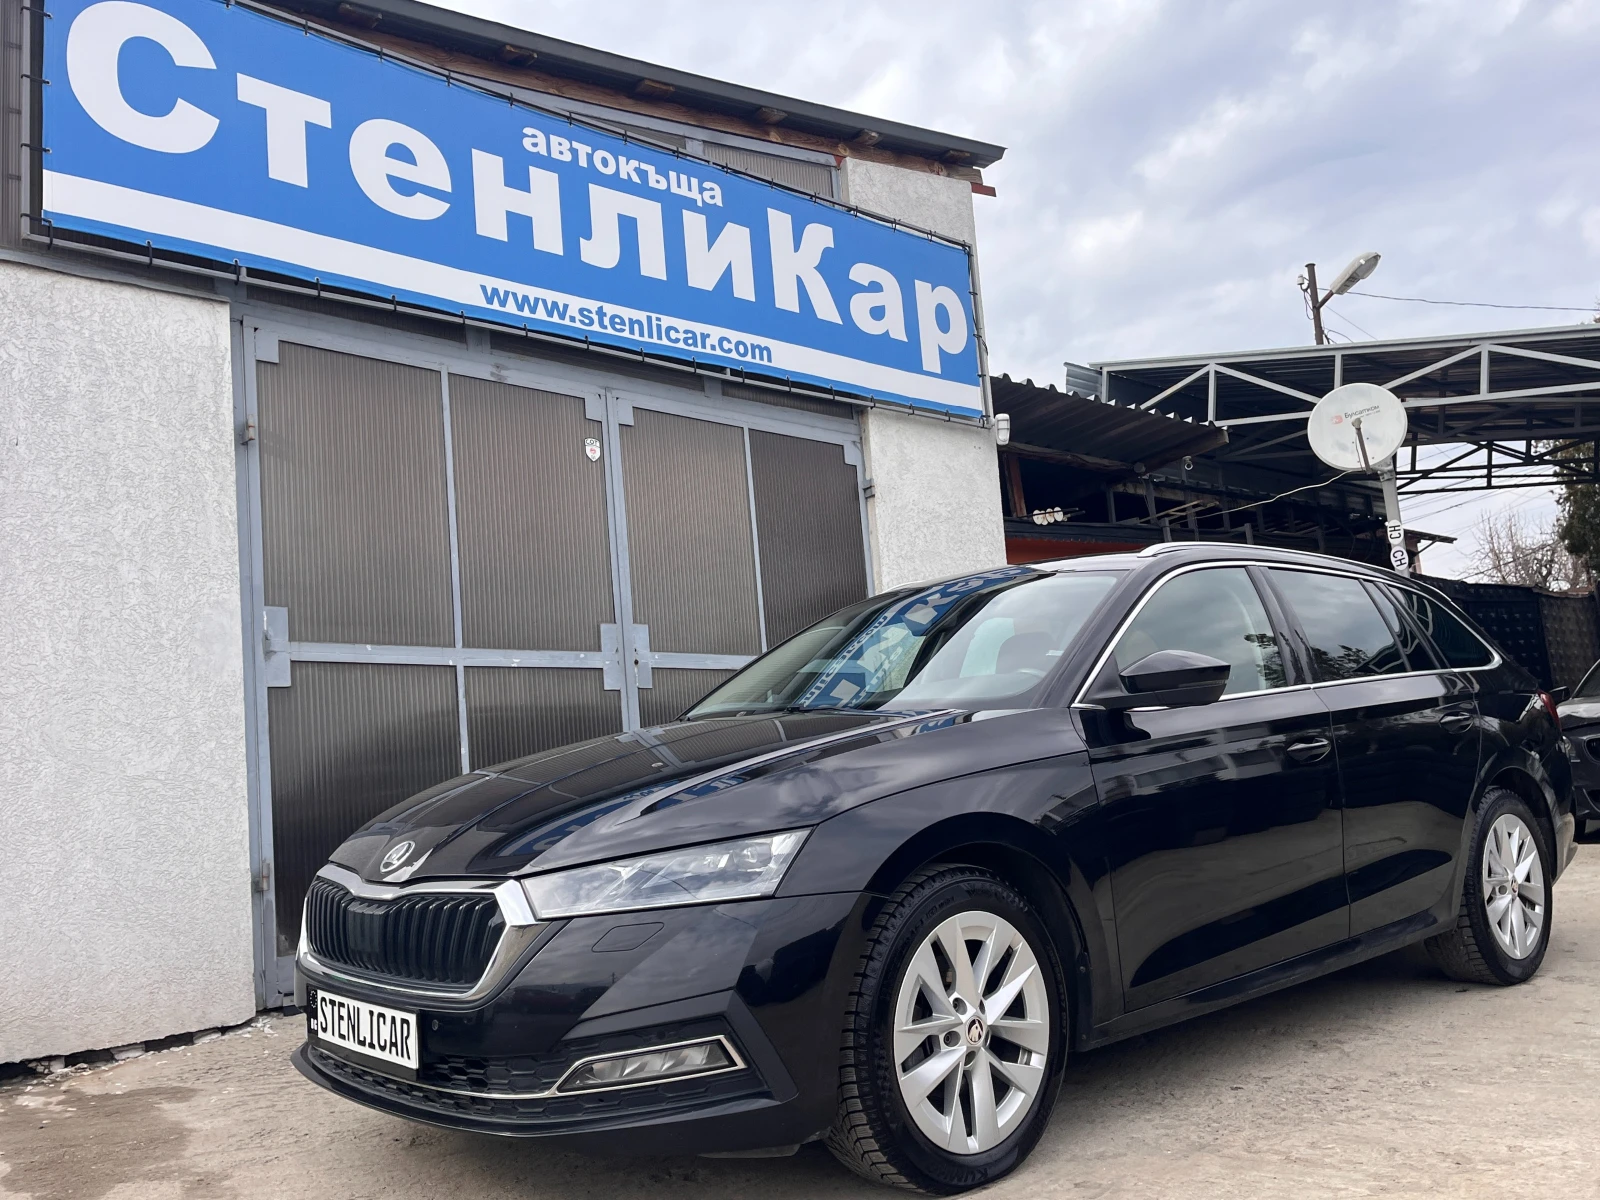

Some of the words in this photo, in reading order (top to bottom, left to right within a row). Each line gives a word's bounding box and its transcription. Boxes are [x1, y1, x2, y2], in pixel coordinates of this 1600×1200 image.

[67, 1, 967, 374] СтенлиКар
[522, 126, 723, 207] автокъща
[480, 285, 773, 364] www.stenlicar.com
[1392, 549, 1407, 567] CH
[320, 996, 411, 1060] STENLICAR
